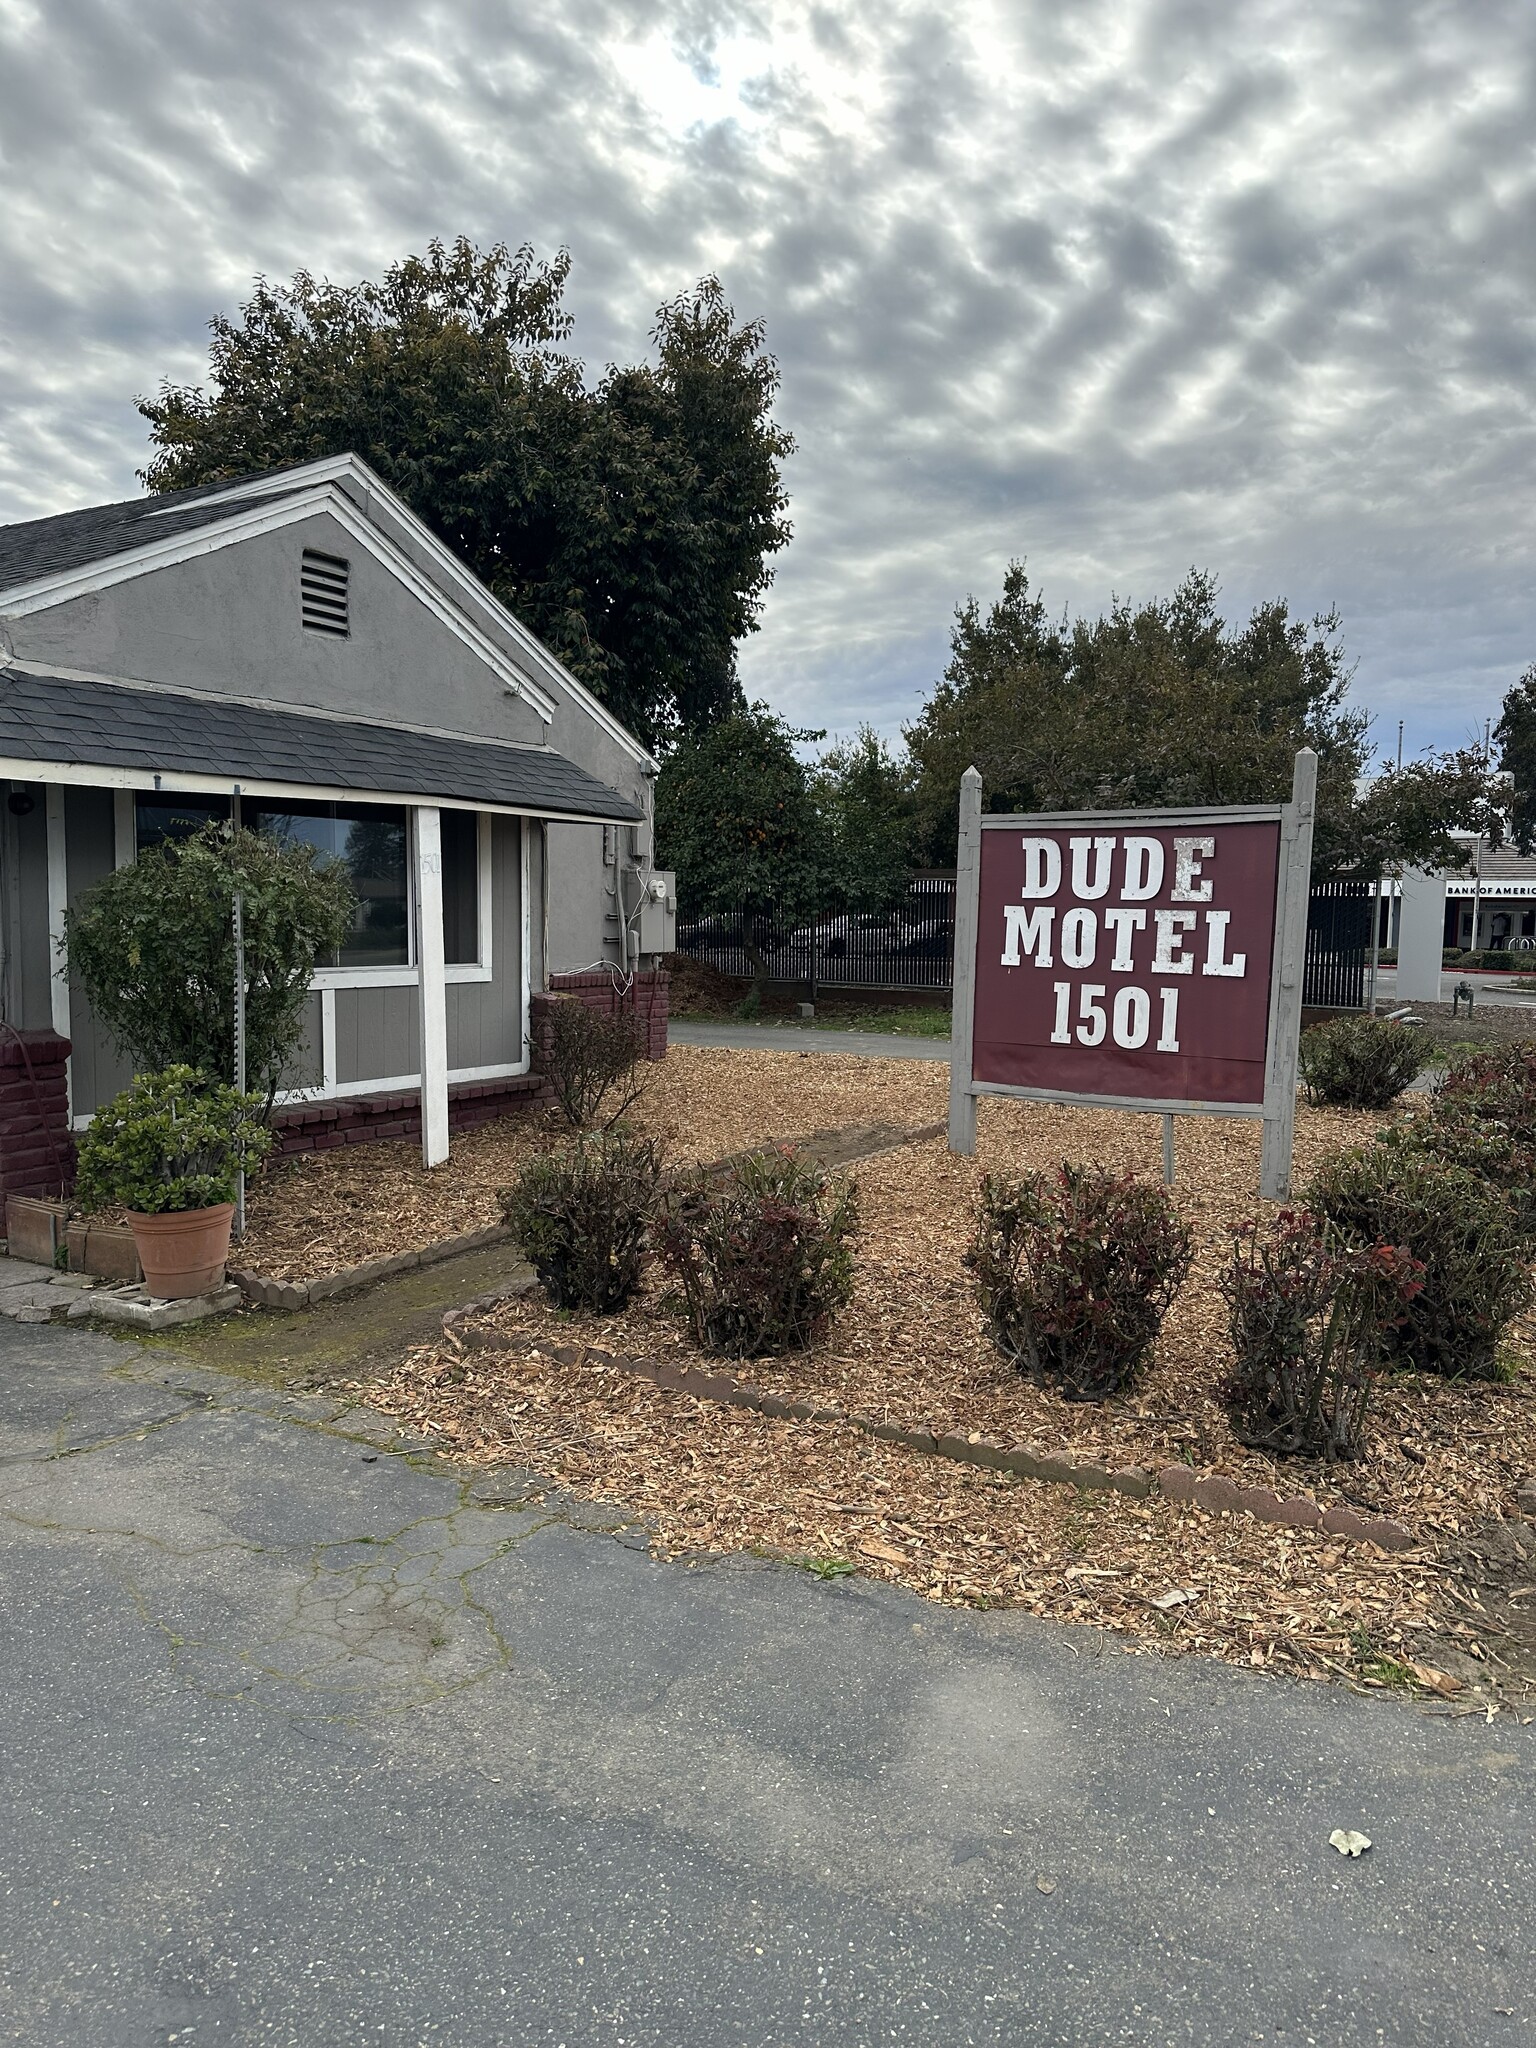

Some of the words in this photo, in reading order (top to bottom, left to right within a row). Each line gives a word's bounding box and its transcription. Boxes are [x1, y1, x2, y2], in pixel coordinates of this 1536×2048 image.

[1021, 836, 1215, 902] DUDE
[1000, 905, 1246, 978] MOTEL
[1050, 982, 1180, 1053] 1501
